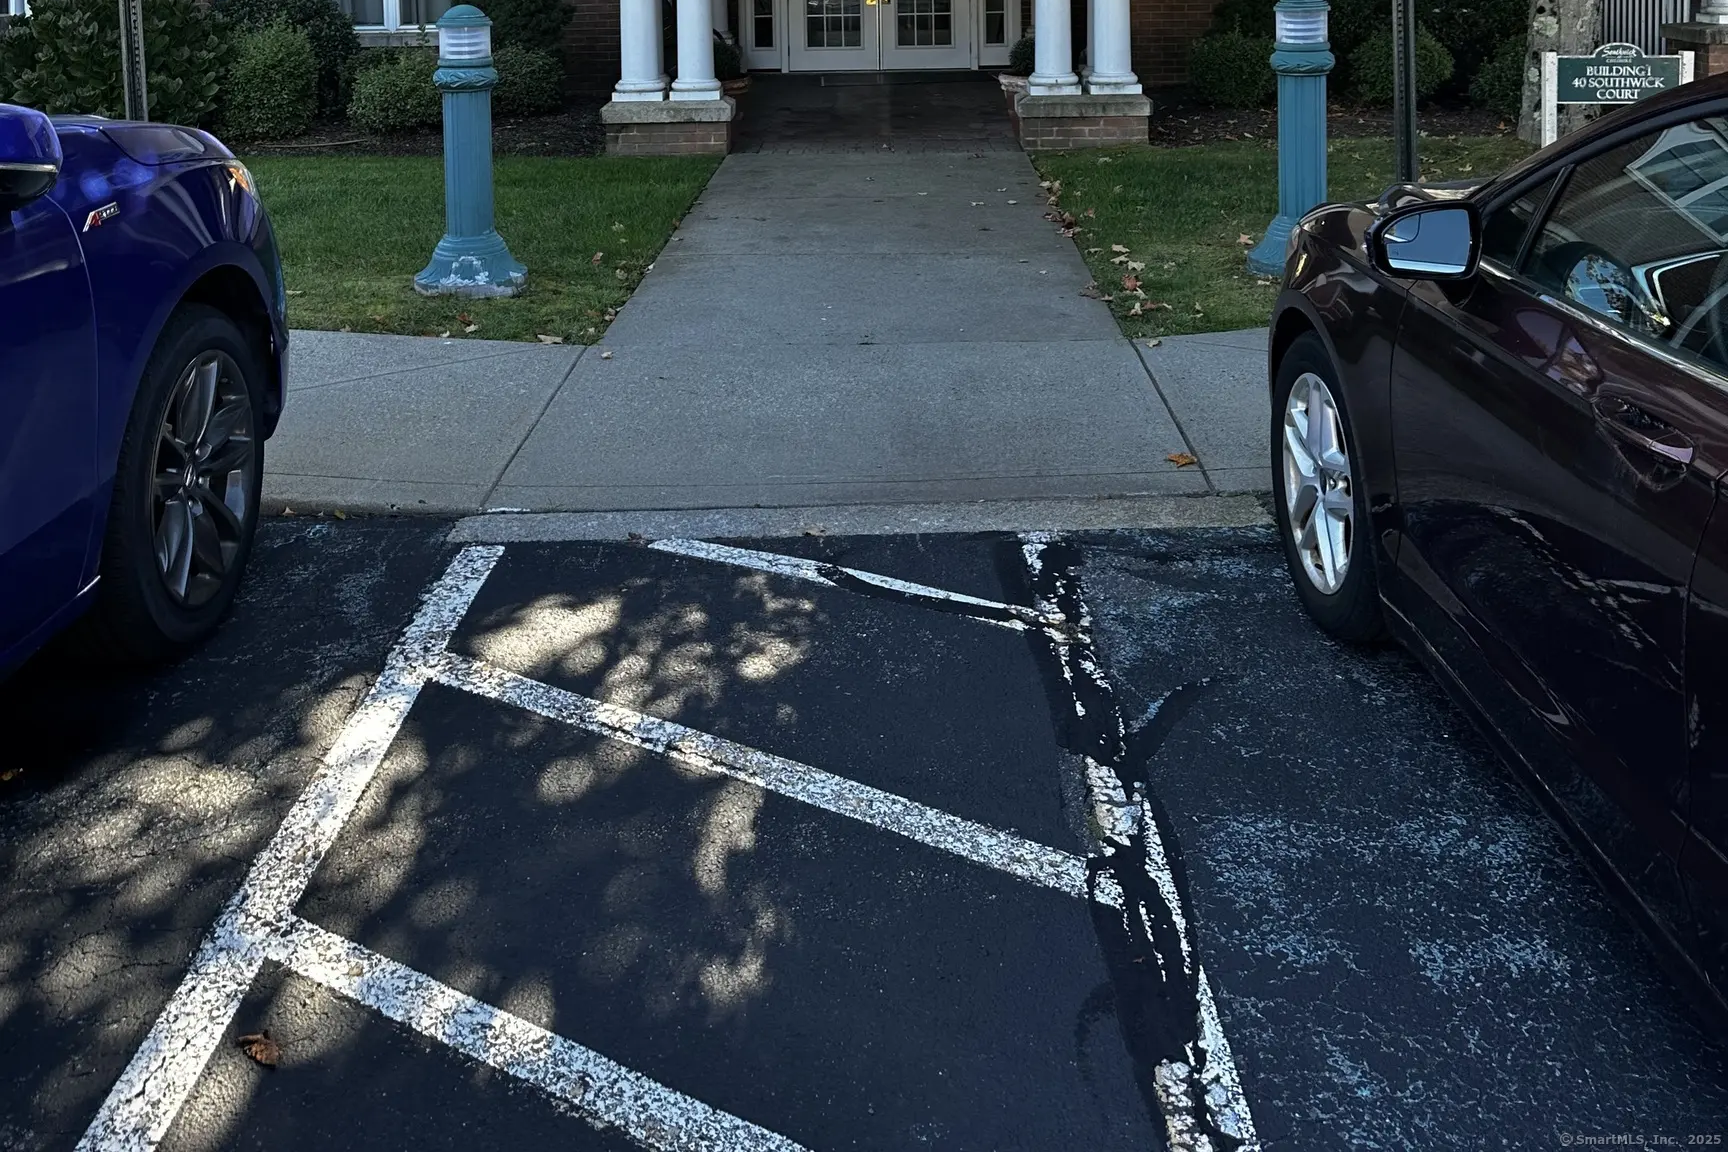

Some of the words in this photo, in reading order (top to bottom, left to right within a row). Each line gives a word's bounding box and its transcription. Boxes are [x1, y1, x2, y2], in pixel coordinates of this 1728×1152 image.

[1586, 65, 1646, 77] BUILDING
[1572, 78, 1587, 89] 40
[1588, 77, 1665, 89] SOUTHWICK
[1596, 89, 1640, 100] COURT
